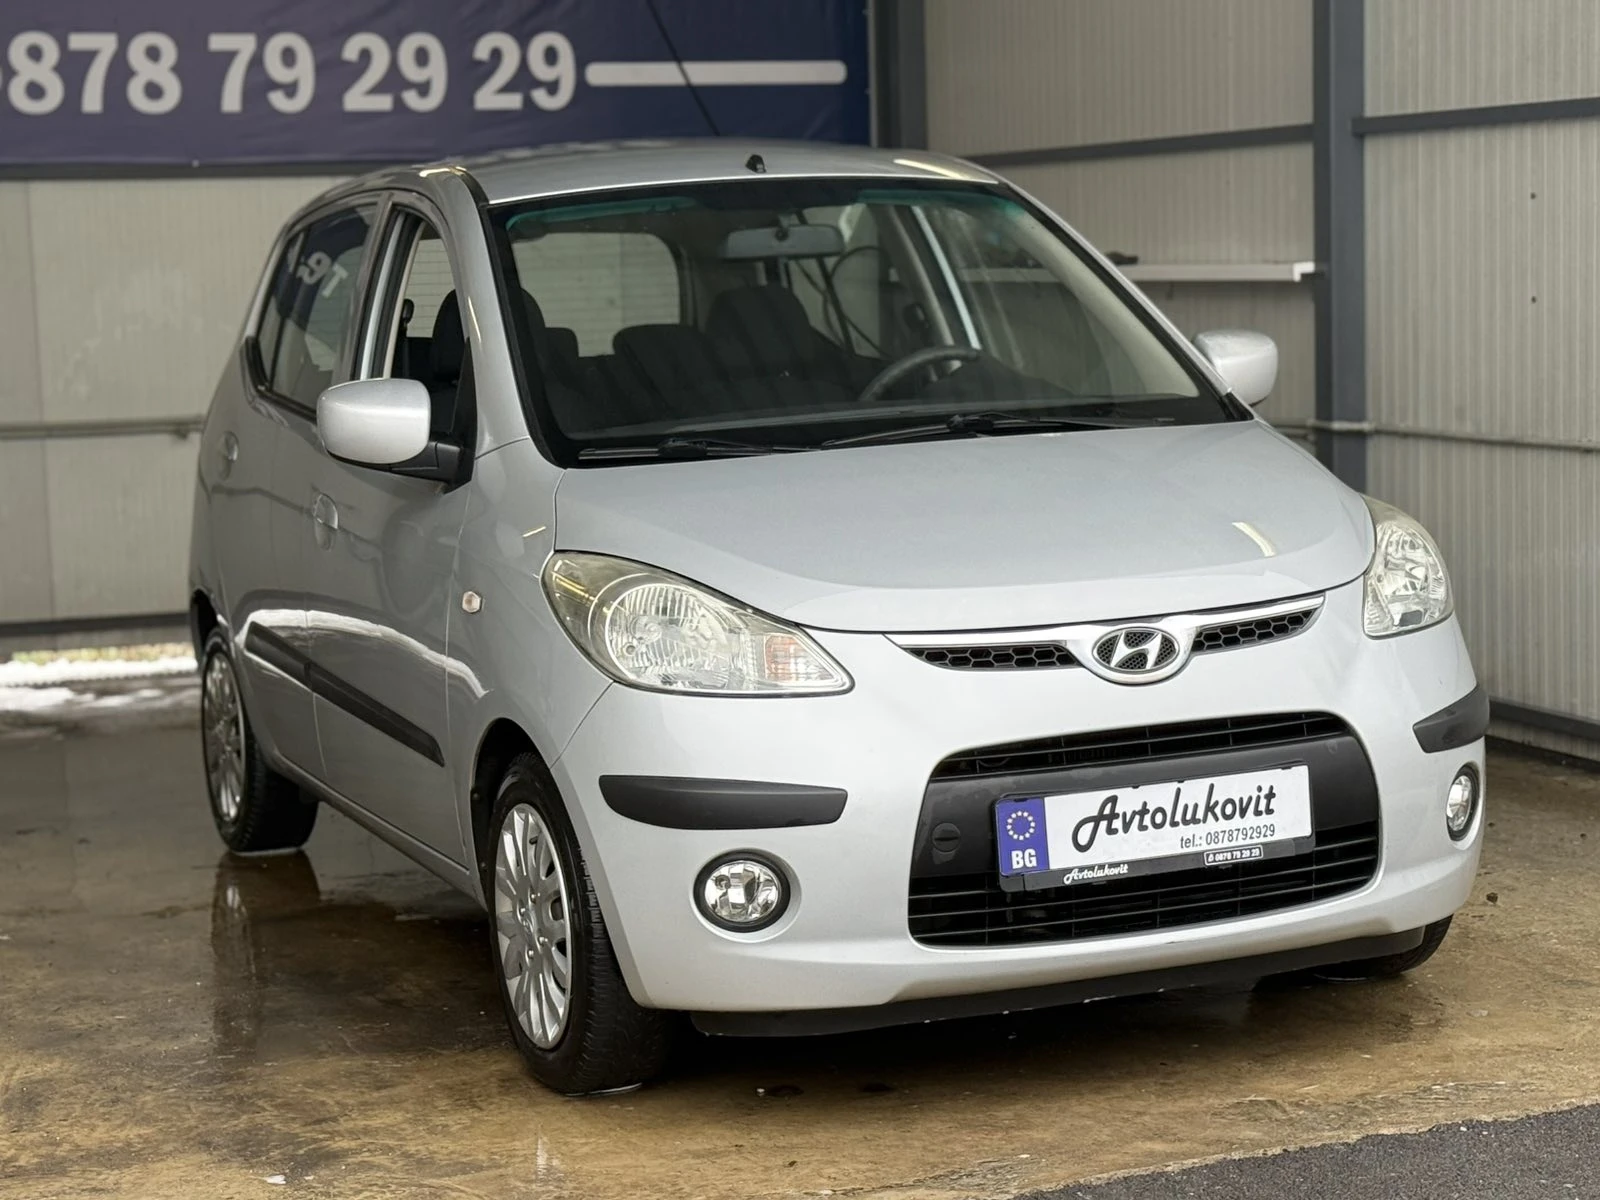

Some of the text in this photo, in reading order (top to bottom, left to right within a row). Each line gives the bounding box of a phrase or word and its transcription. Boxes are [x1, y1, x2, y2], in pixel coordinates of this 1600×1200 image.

[0, 30, 577, 115] 878 79 29 29
[1072, 783, 1276, 853] Avtolukovit
[1180, 823, 1276, 849] tel.: 0878792929
[1010, 848, 1037, 870] BG
[1063, 863, 1129, 885] Avtolukovit
